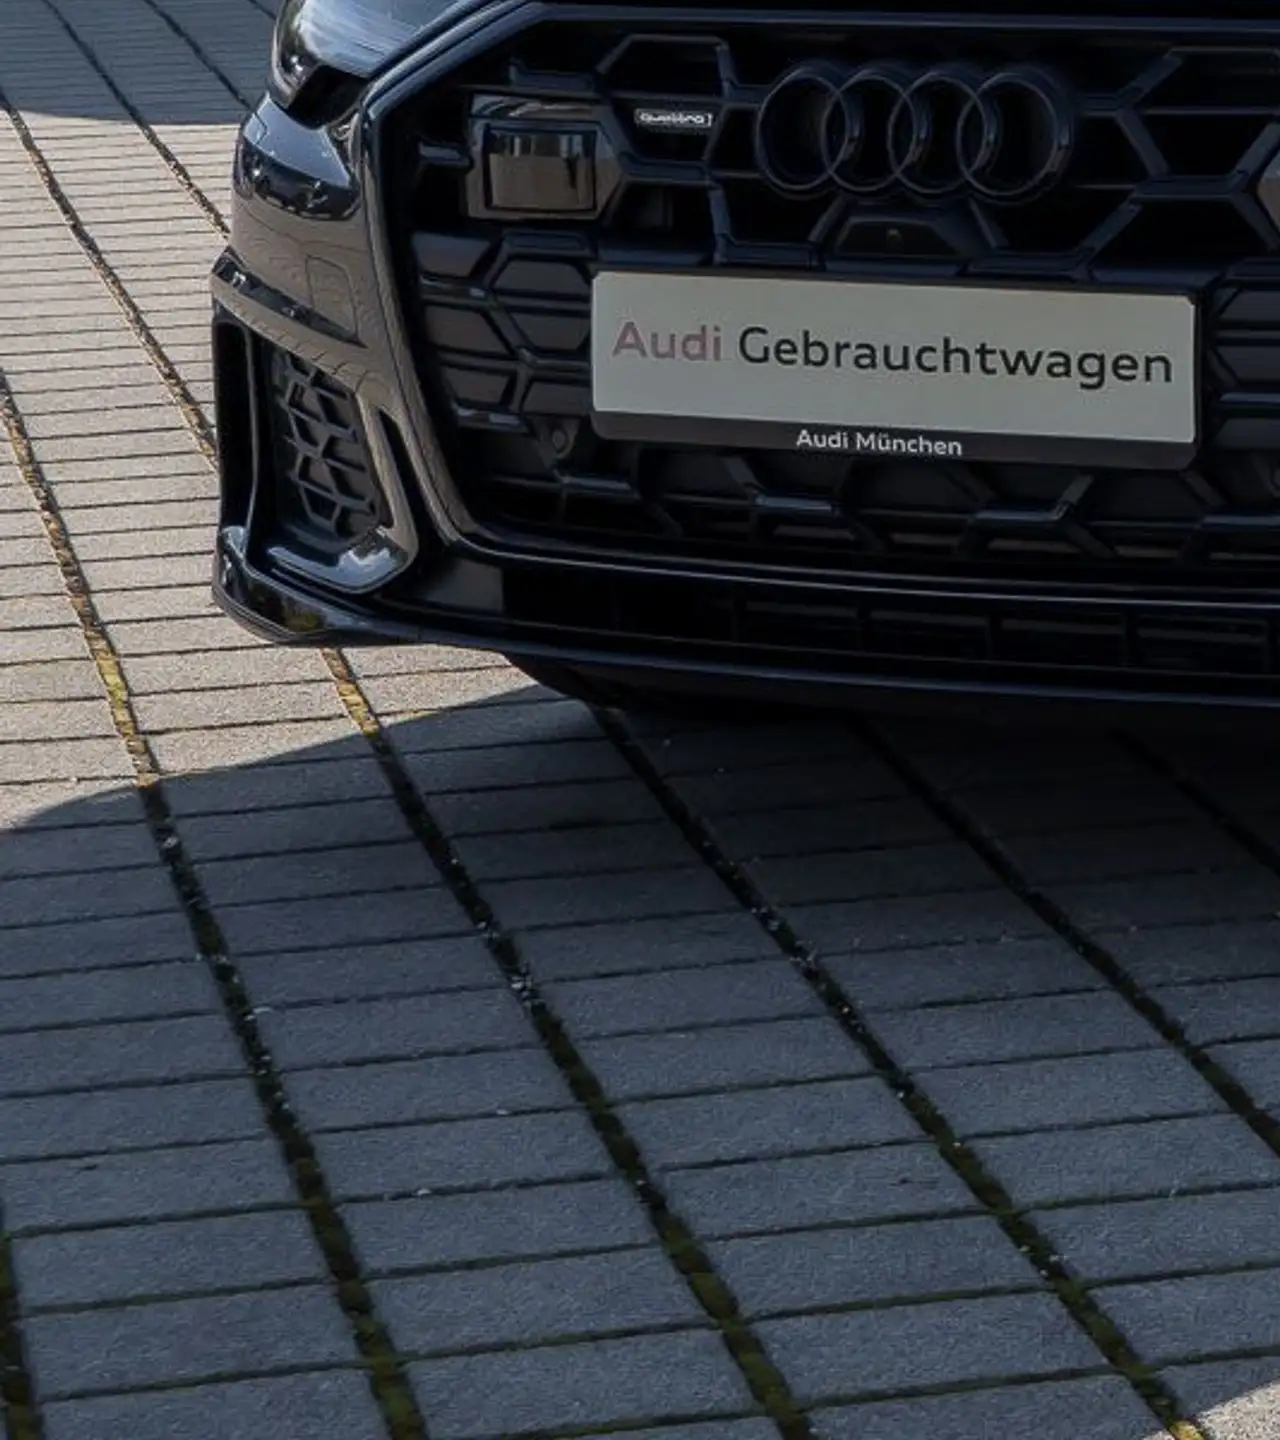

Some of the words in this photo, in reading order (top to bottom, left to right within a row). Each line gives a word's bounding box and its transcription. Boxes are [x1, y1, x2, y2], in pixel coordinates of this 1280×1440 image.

[612, 320, 722, 361] Audi
[738, 325, 1173, 391] Gebrauchtwagen
[796, 428, 849, 449] Audi
[856, 432, 963, 456] München
